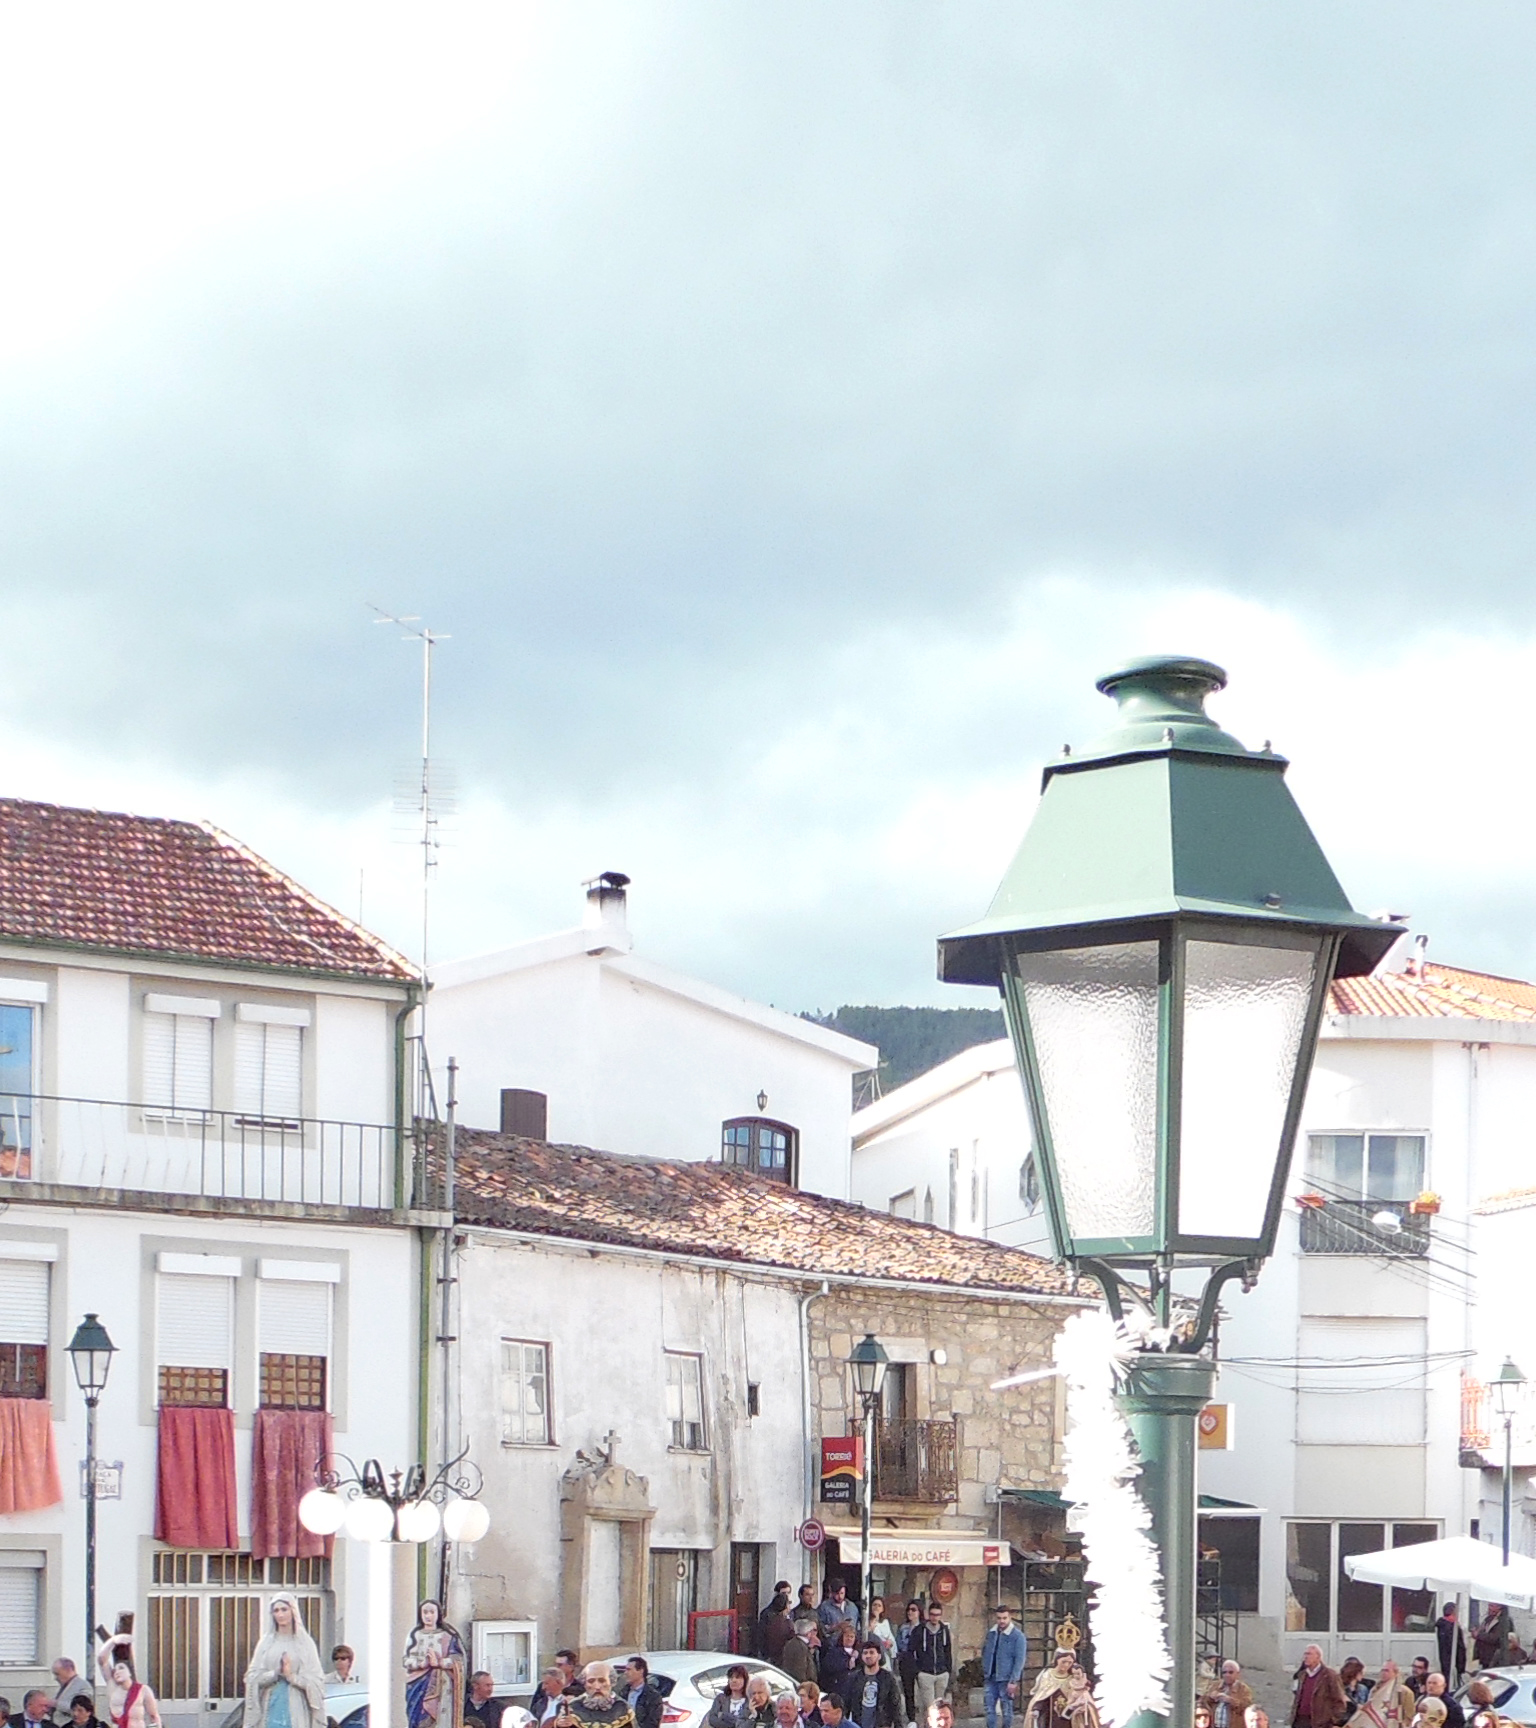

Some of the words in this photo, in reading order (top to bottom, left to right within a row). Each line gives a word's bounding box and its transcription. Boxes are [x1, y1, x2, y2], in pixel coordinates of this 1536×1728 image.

[824, 1481, 850, 1489] GALERIA
[834, 1490, 850, 1498] CAFÉ
[925, 1549, 951, 1562] CAFÉ
